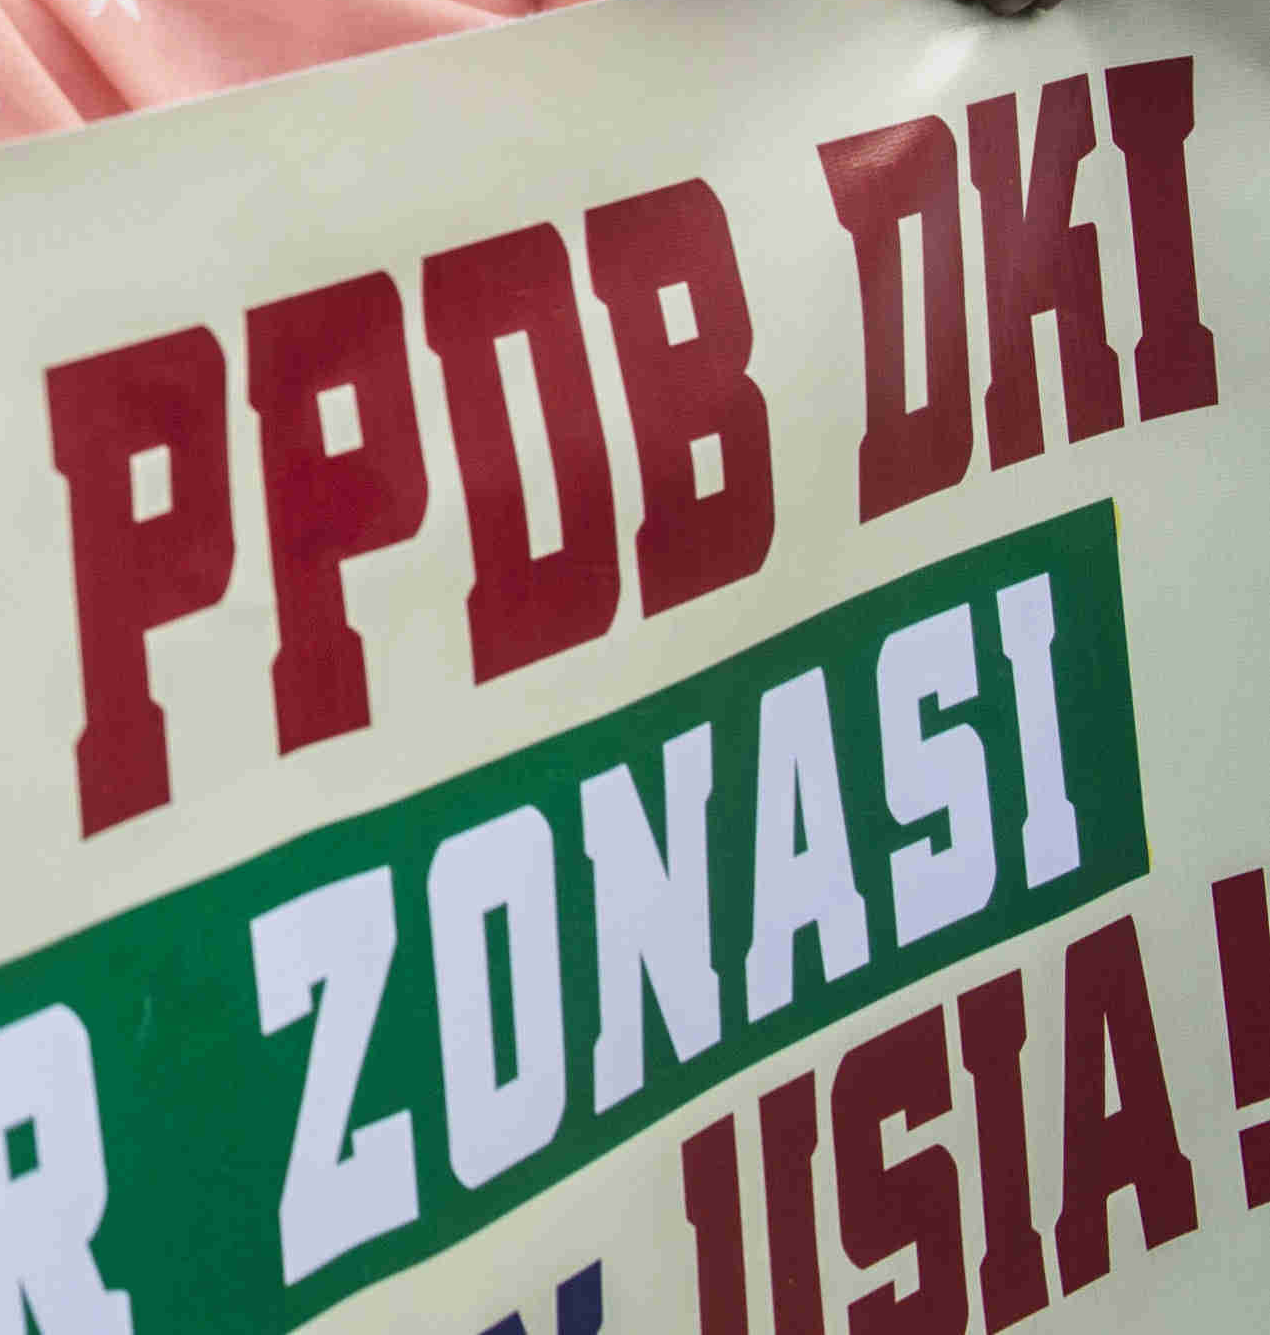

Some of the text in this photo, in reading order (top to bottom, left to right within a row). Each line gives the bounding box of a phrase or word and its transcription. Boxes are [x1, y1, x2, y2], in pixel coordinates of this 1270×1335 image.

[42, 178, 776, 839] PPDB
[816, 55, 1220, 525] DKI
[250, 573, 1080, 1286] ZONASI
